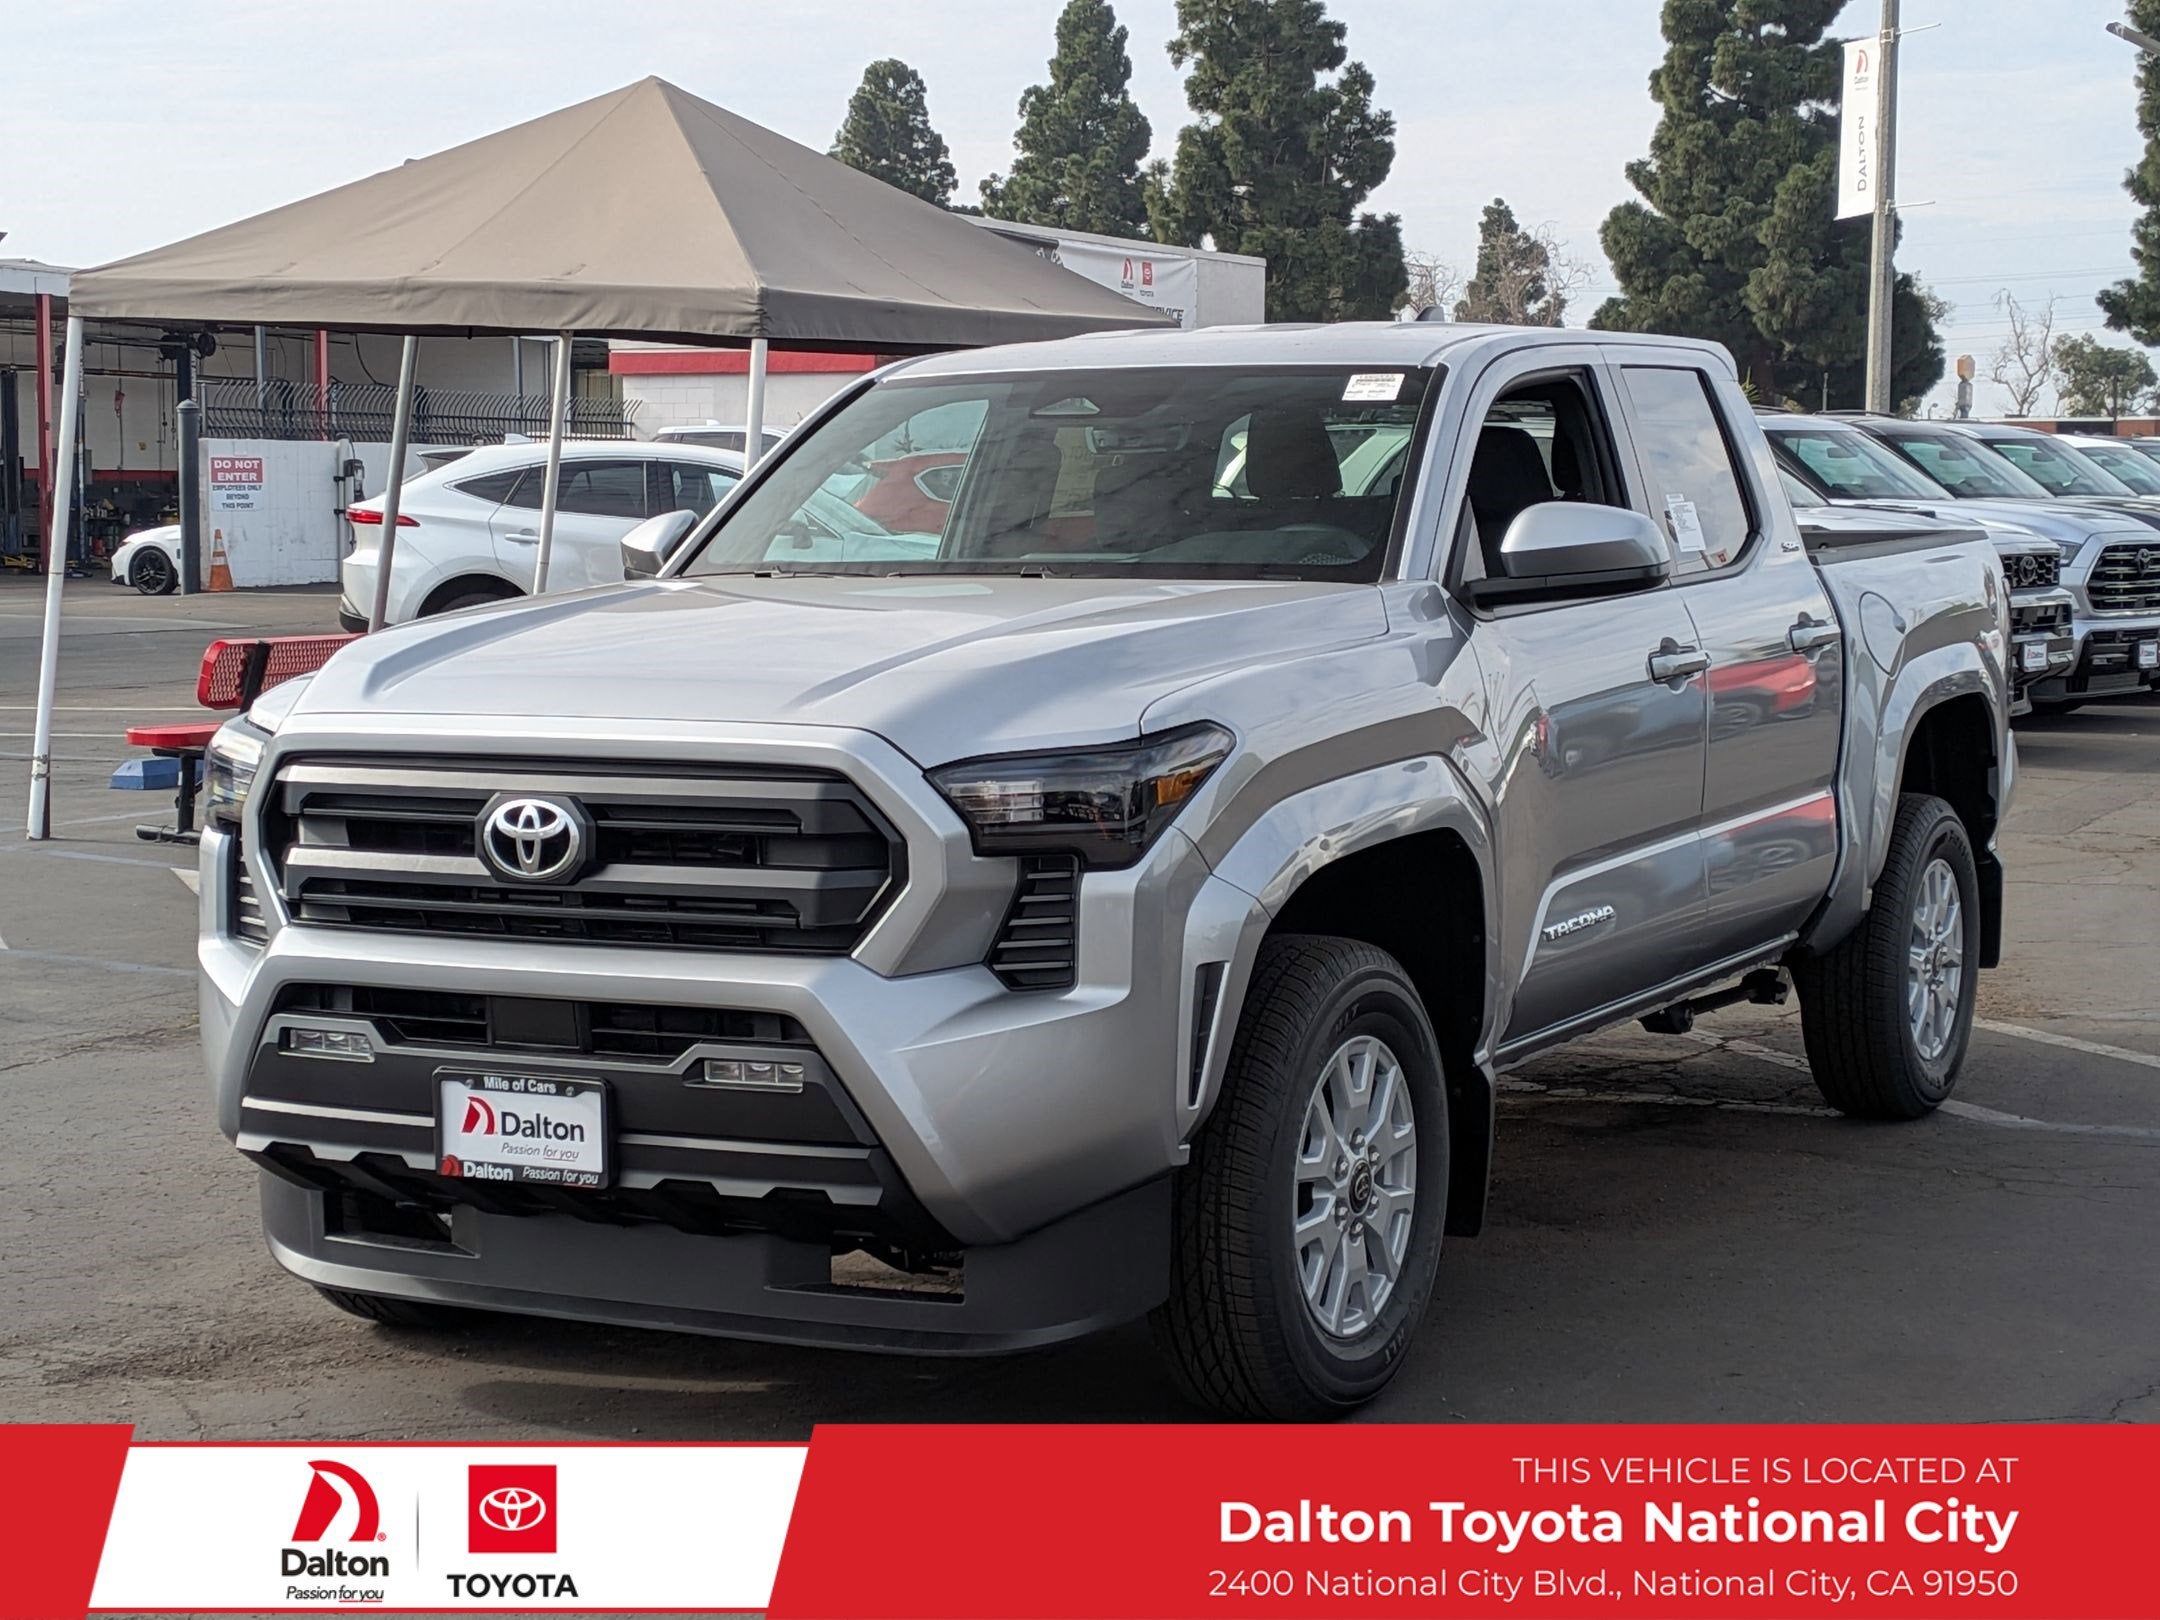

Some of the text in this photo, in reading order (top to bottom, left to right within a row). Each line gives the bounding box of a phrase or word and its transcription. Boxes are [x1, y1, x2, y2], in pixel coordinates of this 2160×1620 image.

[1857, 115, 1868, 192] DALTON
[214, 460, 260, 469] DO NOT
[217, 472, 258, 481] ENTER
[1542, 905, 1616, 941] TACOMA
[484, 1076, 557, 1094] Mile of Cars
[501, 1111, 585, 1142] Dalton
[501, 1142, 580, 1160] Passion for you
[463, 1161, 599, 1185] Dalton Passion for you
